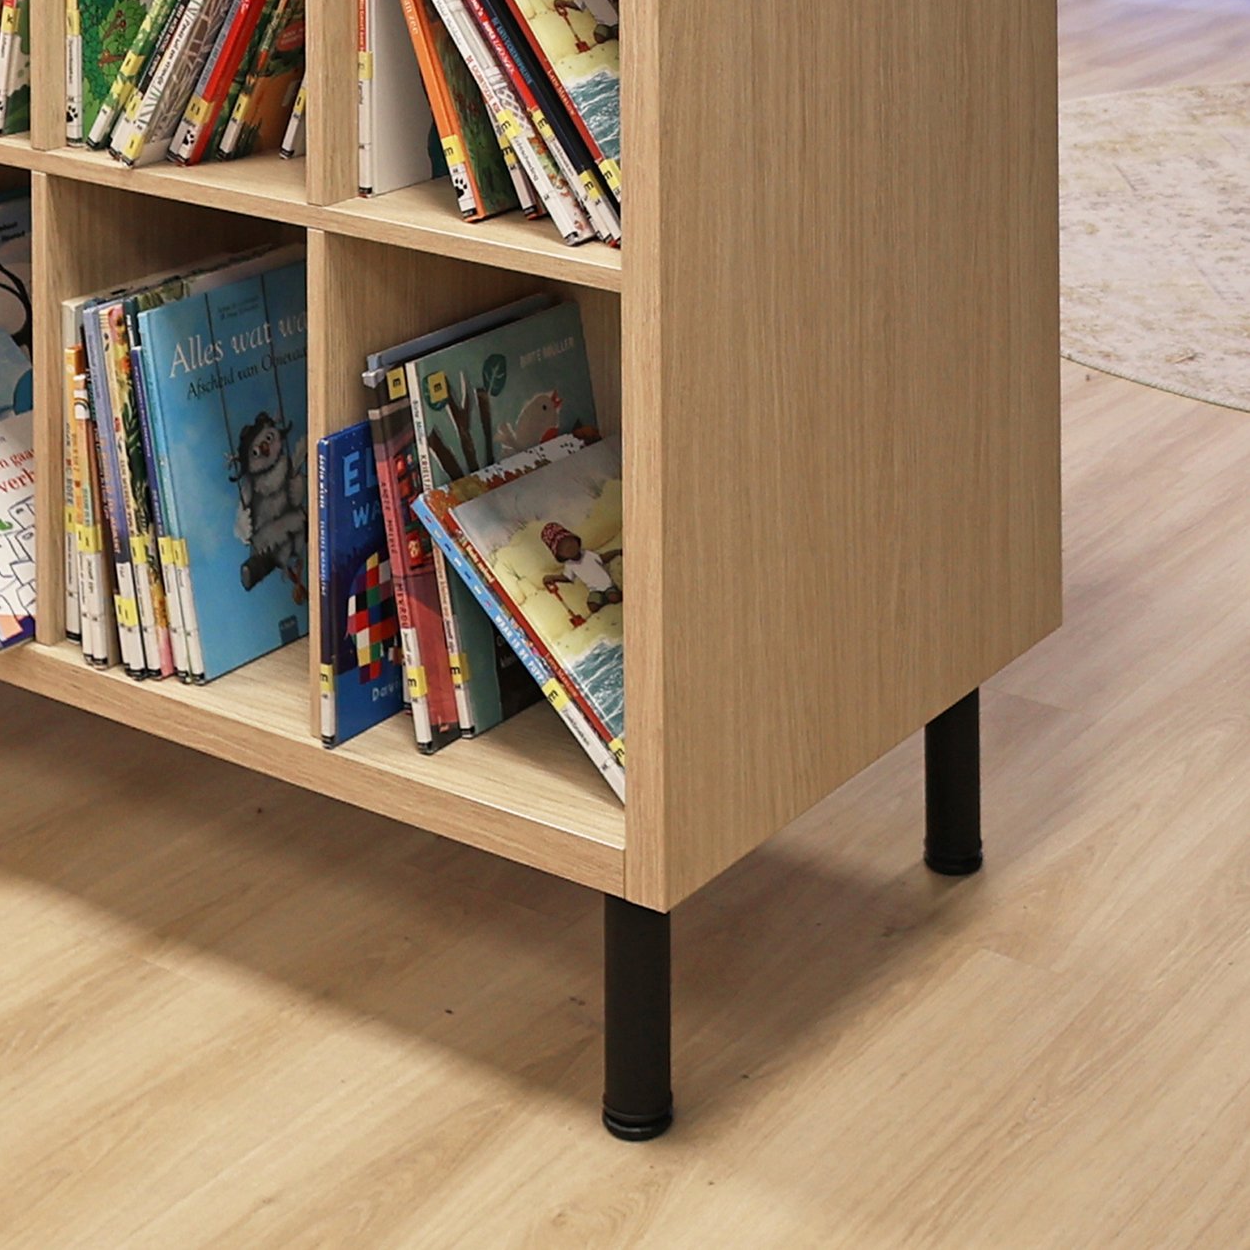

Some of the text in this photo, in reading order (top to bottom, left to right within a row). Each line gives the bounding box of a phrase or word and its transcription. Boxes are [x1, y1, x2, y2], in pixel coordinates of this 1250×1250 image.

[406, 13, 421, 36] zee
[169, 334, 224, 378] Alles
[231, 321, 272, 354] wat
[187, 365, 258, 401] Afscheid van
[9, 448, 36, 468] gaa
[493, 613, 513, 638] WAAR
[510, 637, 522, 649] IS
